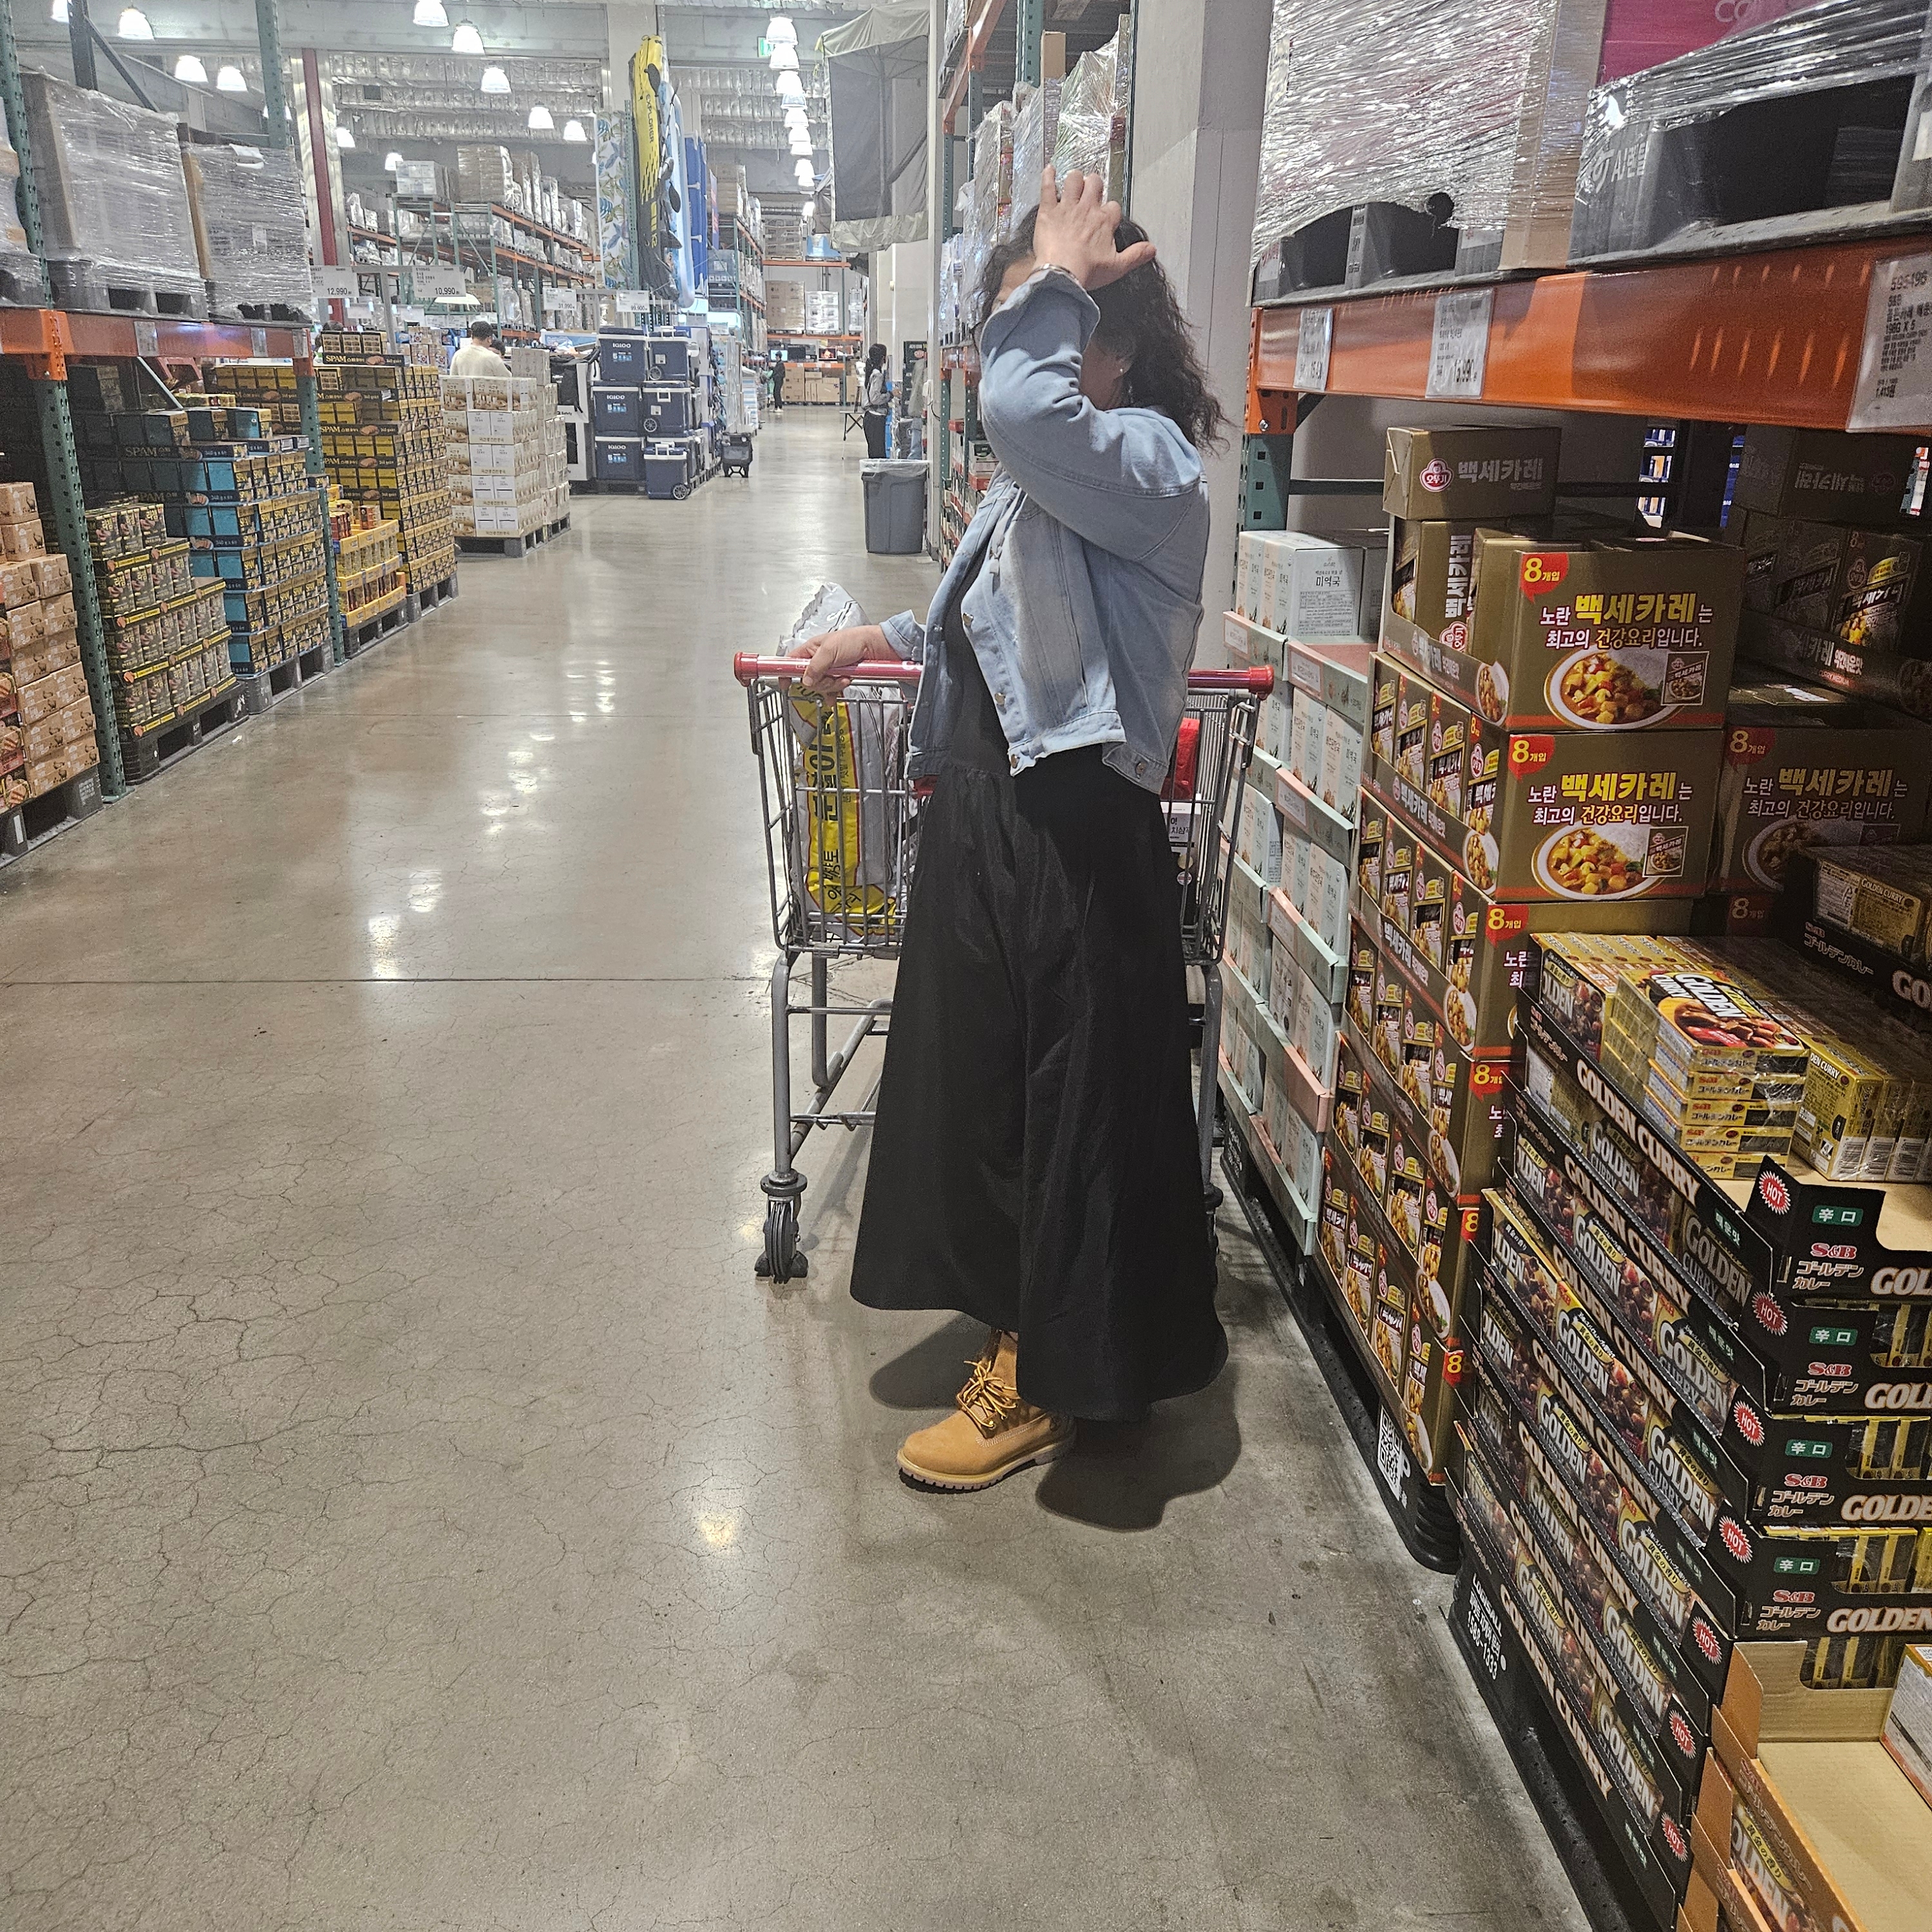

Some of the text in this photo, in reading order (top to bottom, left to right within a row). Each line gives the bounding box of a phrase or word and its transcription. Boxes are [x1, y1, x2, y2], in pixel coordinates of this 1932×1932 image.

[645, 94, 654, 143] EXPLORER
[1458, 457, 1544, 483] 백세카레
[1316, 575, 1341, 587] 미역국
[1444, 535, 1472, 619] 백세카레
[1524, 557, 1560, 583] 8개입
[1540, 592, 1713, 626] 노란 백세카레는
[1546, 627, 1702, 649] 최고의 건강요리입니다.
[1512, 740, 1547, 763] 8개입
[1729, 730, 1766, 754] 8개입
[1528, 772, 1692, 804] 노란 백세카레는
[1744, 767, 1908, 798] 노란 백세카레는
[1400, 782, 1428, 831] 백세카레
[1533, 804, 1683, 826] 최고의 건강요리입니다.
[1748, 799, 1895, 820] 최고의 건강요리입니다.
[1861, 878, 1904, 904] GOLDEN CURRY
[1488, 908, 1522, 930] 8개입
[1383, 920, 1412, 968] 백세카레
[1651, 973, 1748, 1018] CURRY GOLDEN
[1820, 1059, 1841, 1080] CURRY
[1576, 1059, 1701, 1205] GOLDEN CURRY
[1591, 1121, 1640, 1198] GOLDEN
[1766, 1183, 1784, 1204] HOT
[1818, 1208, 1857, 1223] 辛口
[1564, 1153, 1628, 1245] GOLDEN
[1627, 1227, 1692, 1318] CURRY
[1715, 1213, 1740, 1246] 매운맛
[1575, 1215, 1622, 1298] GOLDEN
[1686, 1217, 1752, 1307] GOLDEN
[1811, 1243, 1857, 1260] S&B
[1683, 1253, 1717, 1302] CURRY
[1797, 1260, 1864, 1278] ゴールデン
[1792, 1276, 1831, 1291] カレー
[1760, 1302, 1779, 1325] HOT
[1815, 1329, 1852, 1343] 辛口
[1558, 1311, 1609, 1397] GOLDEN
[1614, 1326, 1678, 1419] CURRY
[1660, 1320, 1728, 1416] GOLDEN
[1808, 1361, 1852, 1377] S&B
[1794, 1379, 1859, 1394] ゴールデン
[1790, 1394, 1827, 1406] カレー
[1540, 1394, 1588, 1483] GOLDEN
[1741, 1414, 1758, 1437] HOT
[1790, 1441, 1826, 1456] 辛口
[1596, 1426, 1661, 1525] CURRY
[1648, 1460, 1684, 1513] CURRY
[1650, 1426, 1717, 1531] GOLDEN
[1784, 1474, 1828, 1489] S&B
[1771, 1490, 1835, 1505] ゴールデン
[1768, 1504, 1804, 1518] カレー
[1727, 1529, 1745, 1553] HOT
[1578, 1514, 1640, 1618] CURRY
[1621, 1520, 1685, 1628] GOLDEN
[1779, 1559, 1814, 1573] 辛口
[1473, 1572, 1502, 1638] LOGISALL
[1517, 1562, 1562, 1657] GOLDEN
[1773, 1589, 1815, 1604] S&B
[1756, 1618, 1792, 1631] カレー
[1759, 1605, 1821, 1619] ゴールデン
[1699, 1631, 1716, 1653] HOT
[1605, 1606, 1665, 1719] GOLDEN
[1501, 1584, 1613, 1801] GOLDEN CURRY
[1675, 1723, 1690, 1747] HOT
[1600, 1703, 1656, 1818] GOLDEN
[1667, 1824, 1682, 1850] HOT
